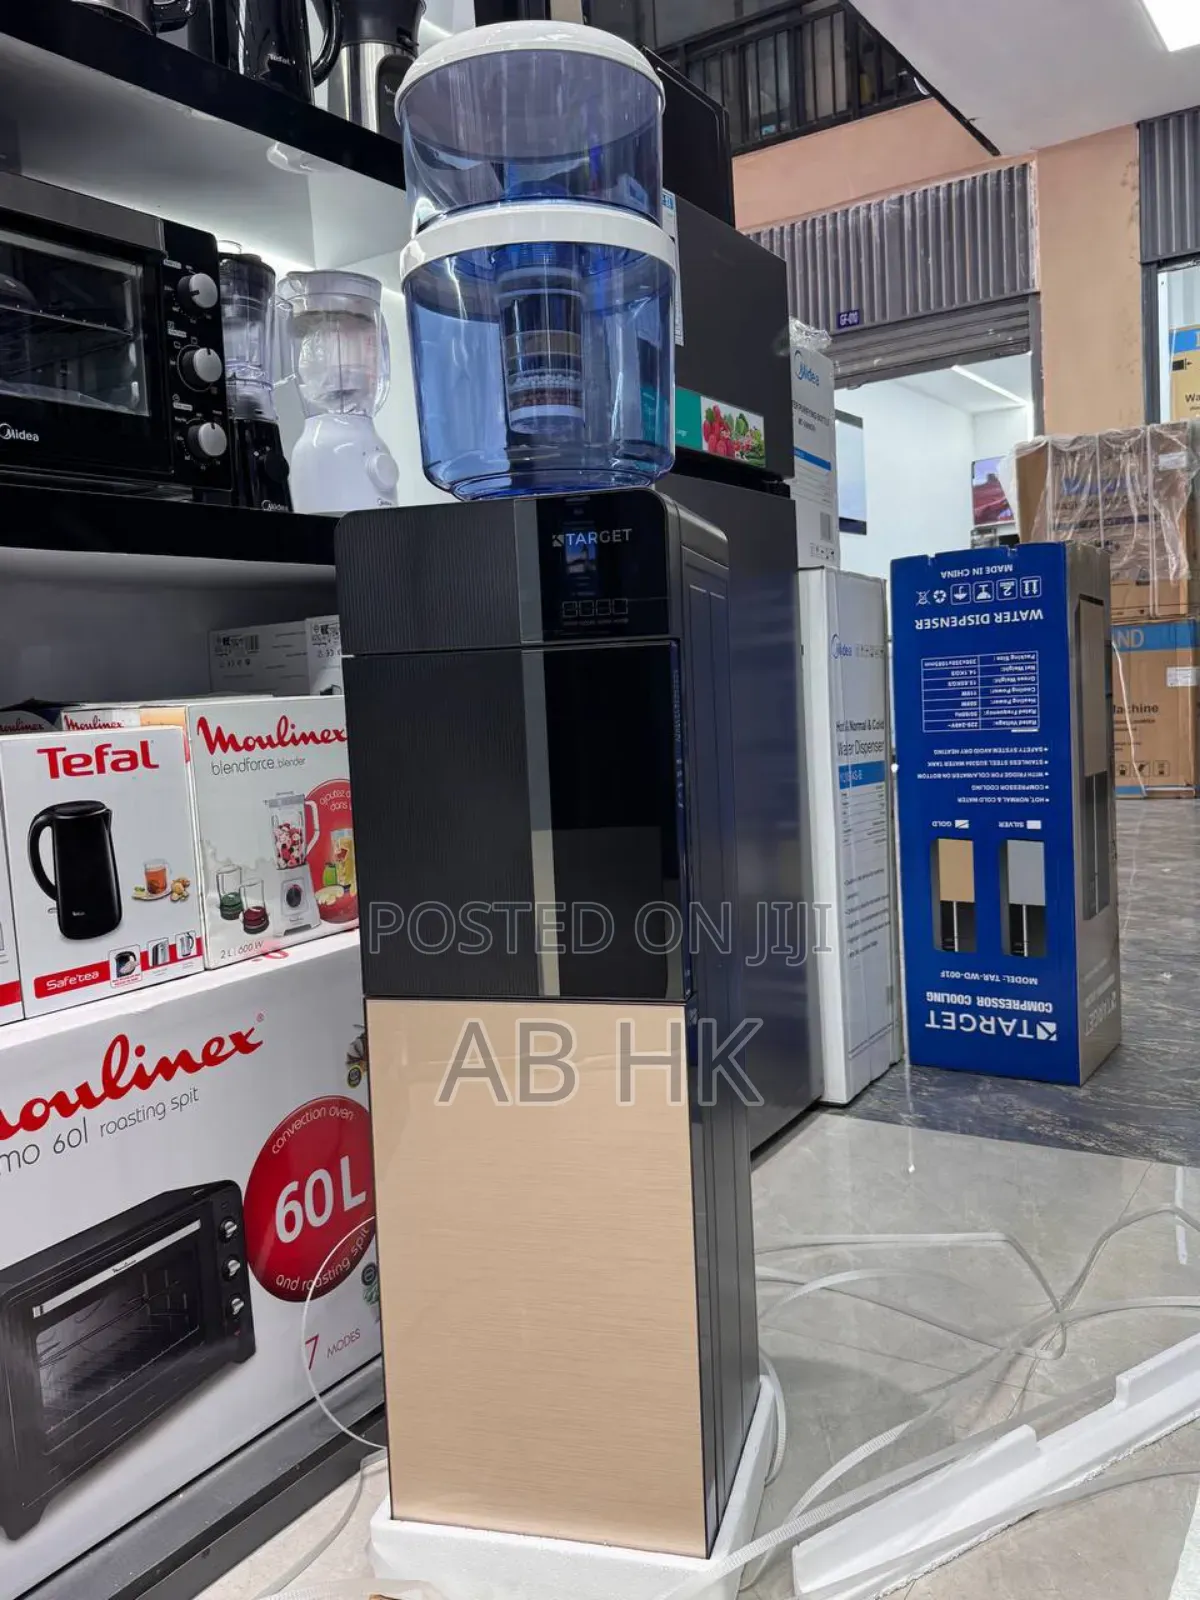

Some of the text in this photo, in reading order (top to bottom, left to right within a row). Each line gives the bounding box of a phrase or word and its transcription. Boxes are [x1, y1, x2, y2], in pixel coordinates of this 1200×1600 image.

[1, 423, 40, 442] Midea
[565, 528, 633, 546] TARGET
[940, 564, 1013, 579] MADE IN CHINA
[914, 608, 1043, 630] WATER DISPENSER
[1113, 703, 1159, 716] achine
[64, 715, 124, 731] Moulinex
[197, 715, 347, 755] Moulinex
[854, 740, 884, 757] Dispenser
[37, 740, 159, 779] Tefal
[211, 757, 305, 775] blendforce blender
[932, 820, 952, 828] GOLD
[239, 943, 254, 954] 600
[255, 941, 264, 951] W
[940, 970, 1038, 985] MODEL: TAR-WD-001F
[926, 991, 1053, 1013] COMPRESSOR COOLING
[925, 1010, 1034, 1038] TARGET
[100, 1101, 166, 1137] roasting
[171, 1086, 200, 1112] spit
[272, 1105, 354, 1154] convection oven
[275, 1155, 366, 1244] 60 L
[276, 1224, 371, 1292] and roasting spit
[305, 1328, 361, 1371] 7 MODES
